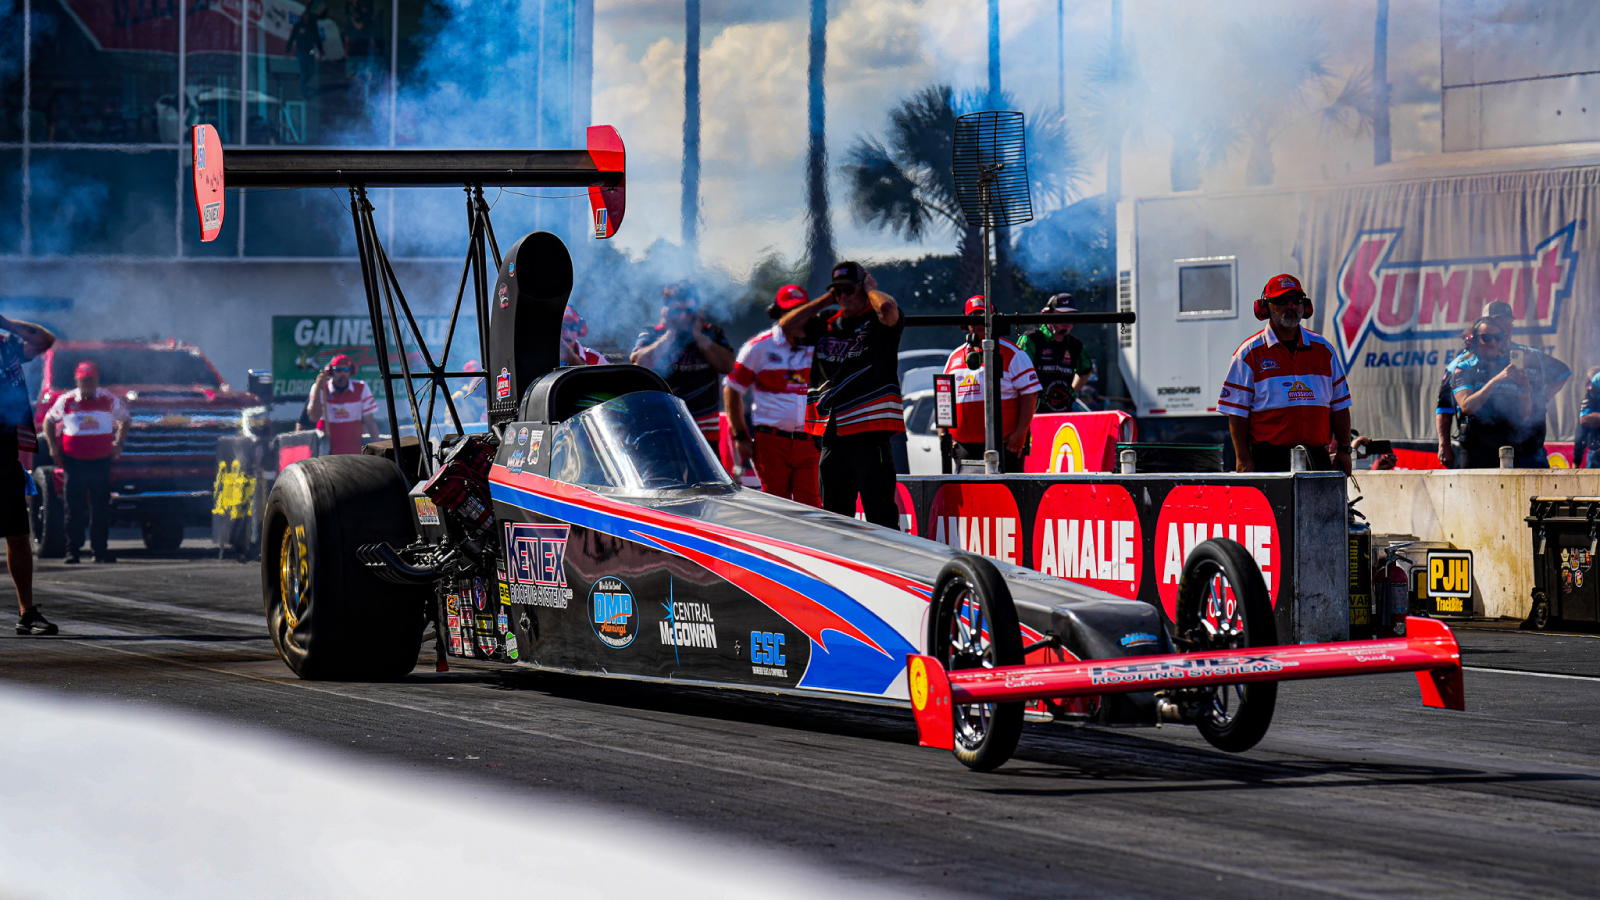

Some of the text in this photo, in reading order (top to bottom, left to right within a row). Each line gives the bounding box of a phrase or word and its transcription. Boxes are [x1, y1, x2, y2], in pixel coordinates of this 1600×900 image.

[1337, 225, 1572, 364] SUMMIT
[1364, 350, 1439, 368] RACING
[1041, 519, 1135, 581] AMALIE
[1349, 540, 1359, 588] FIREBULL
[1430, 558, 1469, 591] PJH
[594, 592, 632, 625] DMP
[673, 602, 714, 622] CENTRAL
[659, 621, 717, 648] McGOWAN
[751, 631, 786, 666] ESC
[1092, 662, 1283, 685] ROOFING SYSTEMS
